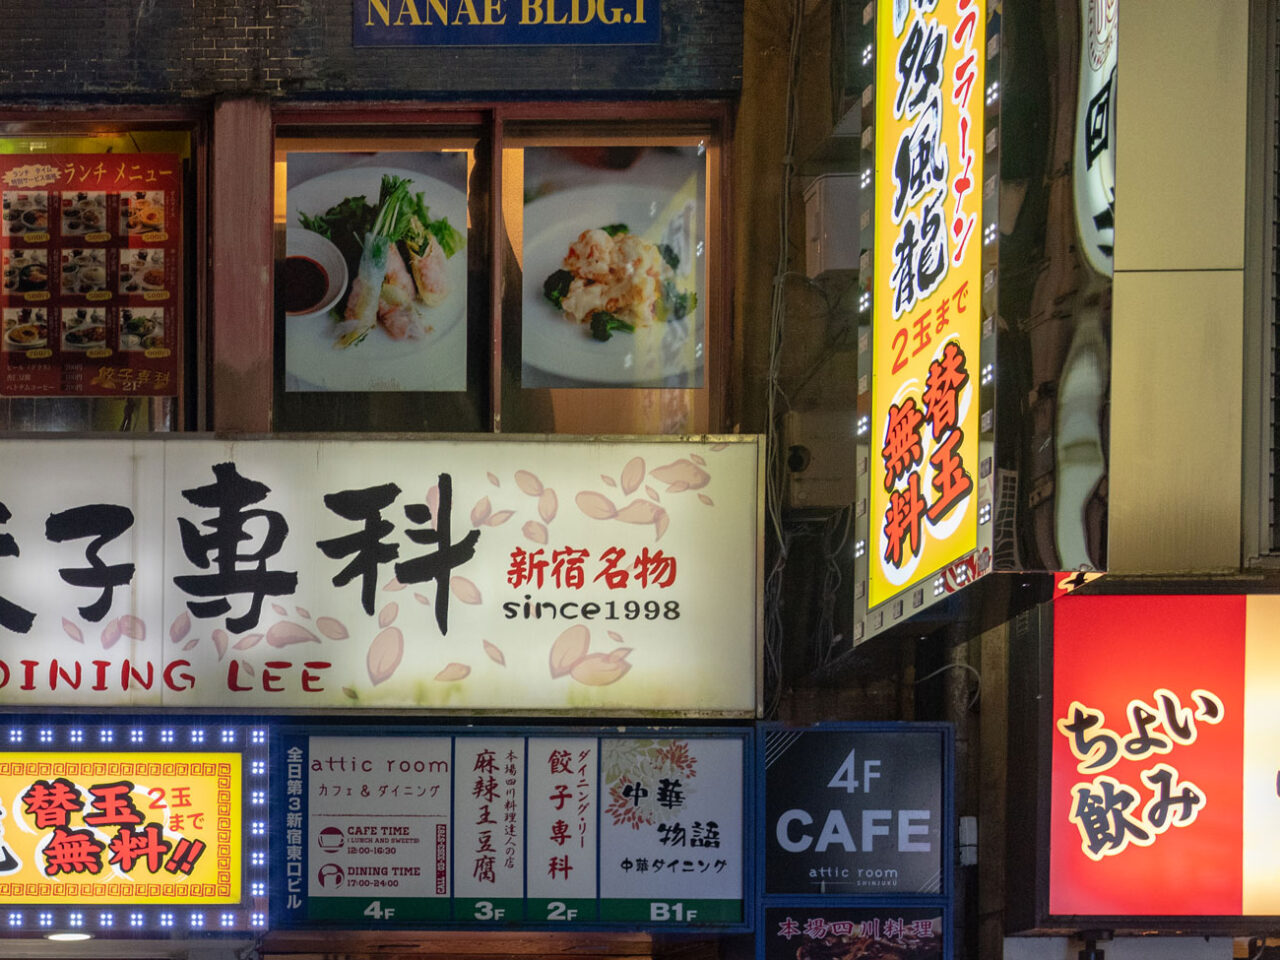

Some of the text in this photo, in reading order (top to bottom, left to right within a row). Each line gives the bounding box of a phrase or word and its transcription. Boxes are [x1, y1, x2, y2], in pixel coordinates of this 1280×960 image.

[365, 0, 507, 26] NANAE
[64, 162, 173, 184] ランチ メニュー
[891, 281, 969, 374] 2玉まで
[923, 343, 971, 521] 替玉
[883, 400, 923, 567] 無料
[507, 546, 677, 590] 新宿名物
[503, 594, 681, 620] since1998
[227, 660, 333, 692] LEE
[1062, 691, 1221, 771] ちょい
[311, 757, 448, 773] attic room
[827, 748, 881, 793] 4F
[22, 779, 144, 829] 替玉
[148, 787, 192, 809] 2玉
[319, 784, 440, 798] カフェ & ダイニング
[622, 778, 687, 810] 中華
[168, 812, 206, 832] まで
[472, 749, 501, 883] 麻辣王豆腐
[548, 750, 574, 880] 餃子専科
[1074, 769, 1202, 856] 飲み
[286, 747, 303, 909] 全日第3新宿東口ビル
[347, 826, 410, 836] CAFE TIME
[656, 821, 721, 849] 物語
[776, 809, 931, 852] CAFE
[347, 867, 421, 876] DINING TIME
[620, 858, 727, 873] 中華ダイニング
[809, 866, 898, 878] attic room
[364, 901, 395, 920] 4F
[474, 901, 505, 921] 3F
[547, 902, 578, 921] 2F
[650, 902, 698, 921] B1F
[777, 917, 935, 940] 本場四川料理
